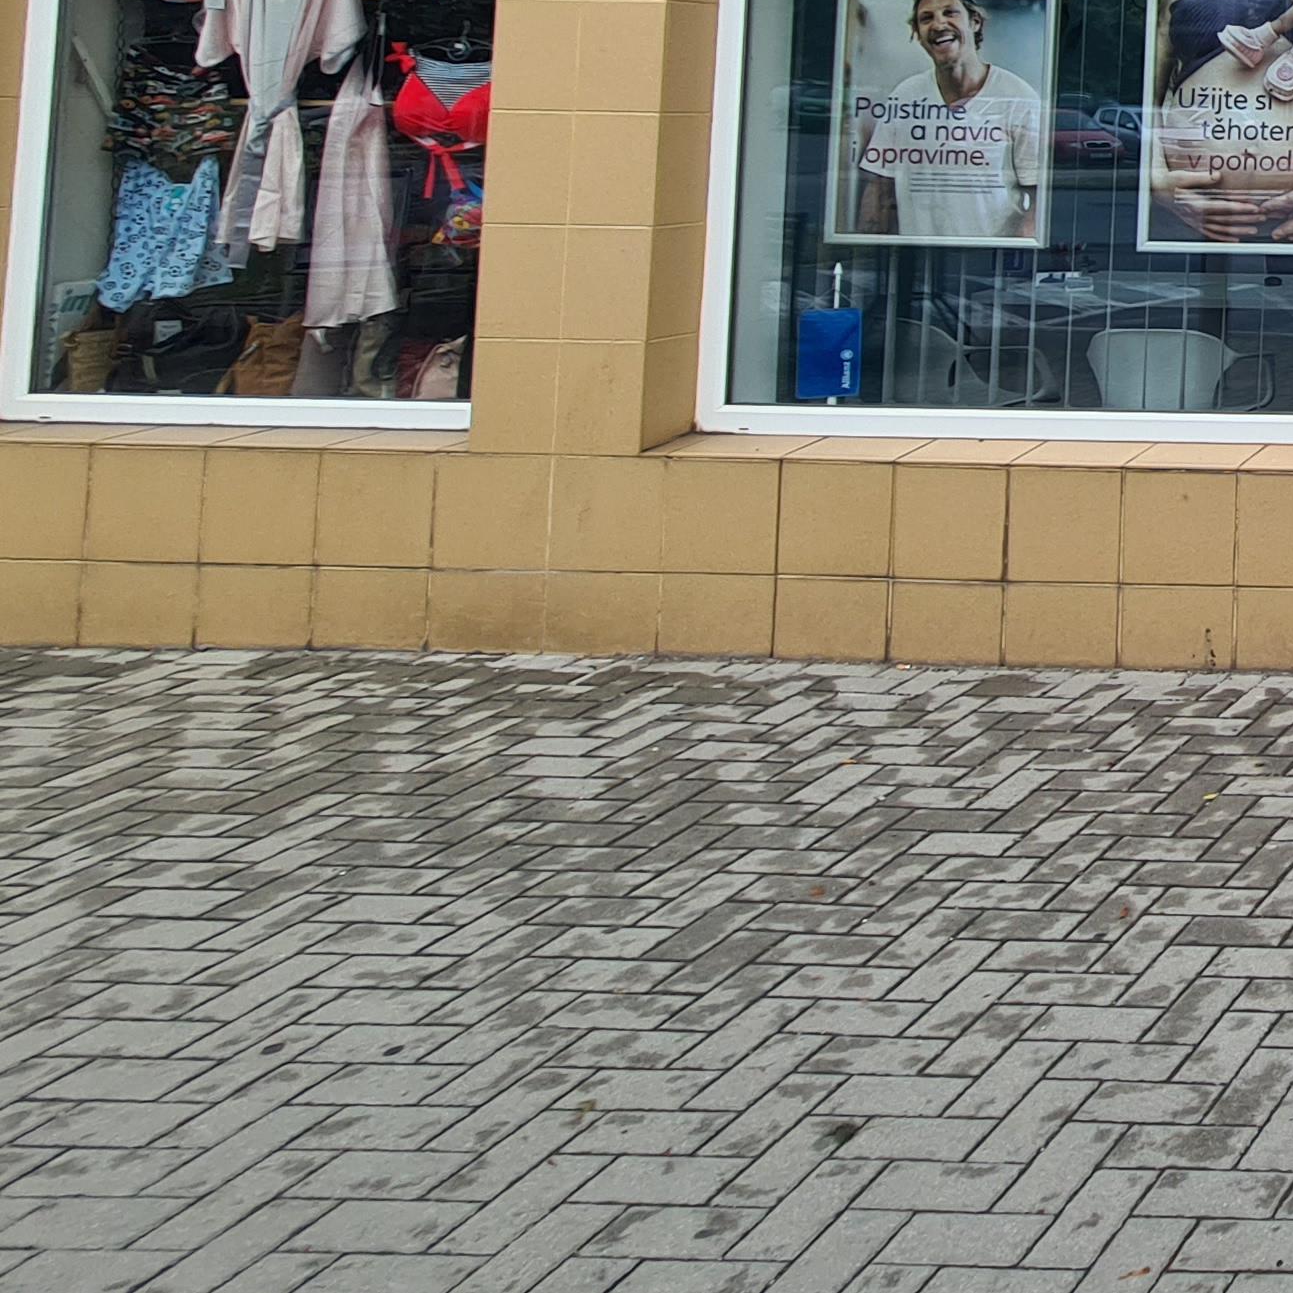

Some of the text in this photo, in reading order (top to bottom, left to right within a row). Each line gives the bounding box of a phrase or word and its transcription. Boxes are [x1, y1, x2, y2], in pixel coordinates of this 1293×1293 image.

[854, 96, 967, 124] Pojistíme
[1179, 87, 1274, 115] Užijte si
[910, 120, 1003, 142] a navíc
[864, 142, 991, 169] opravíme.
[1188, 155, 1202, 170] v
